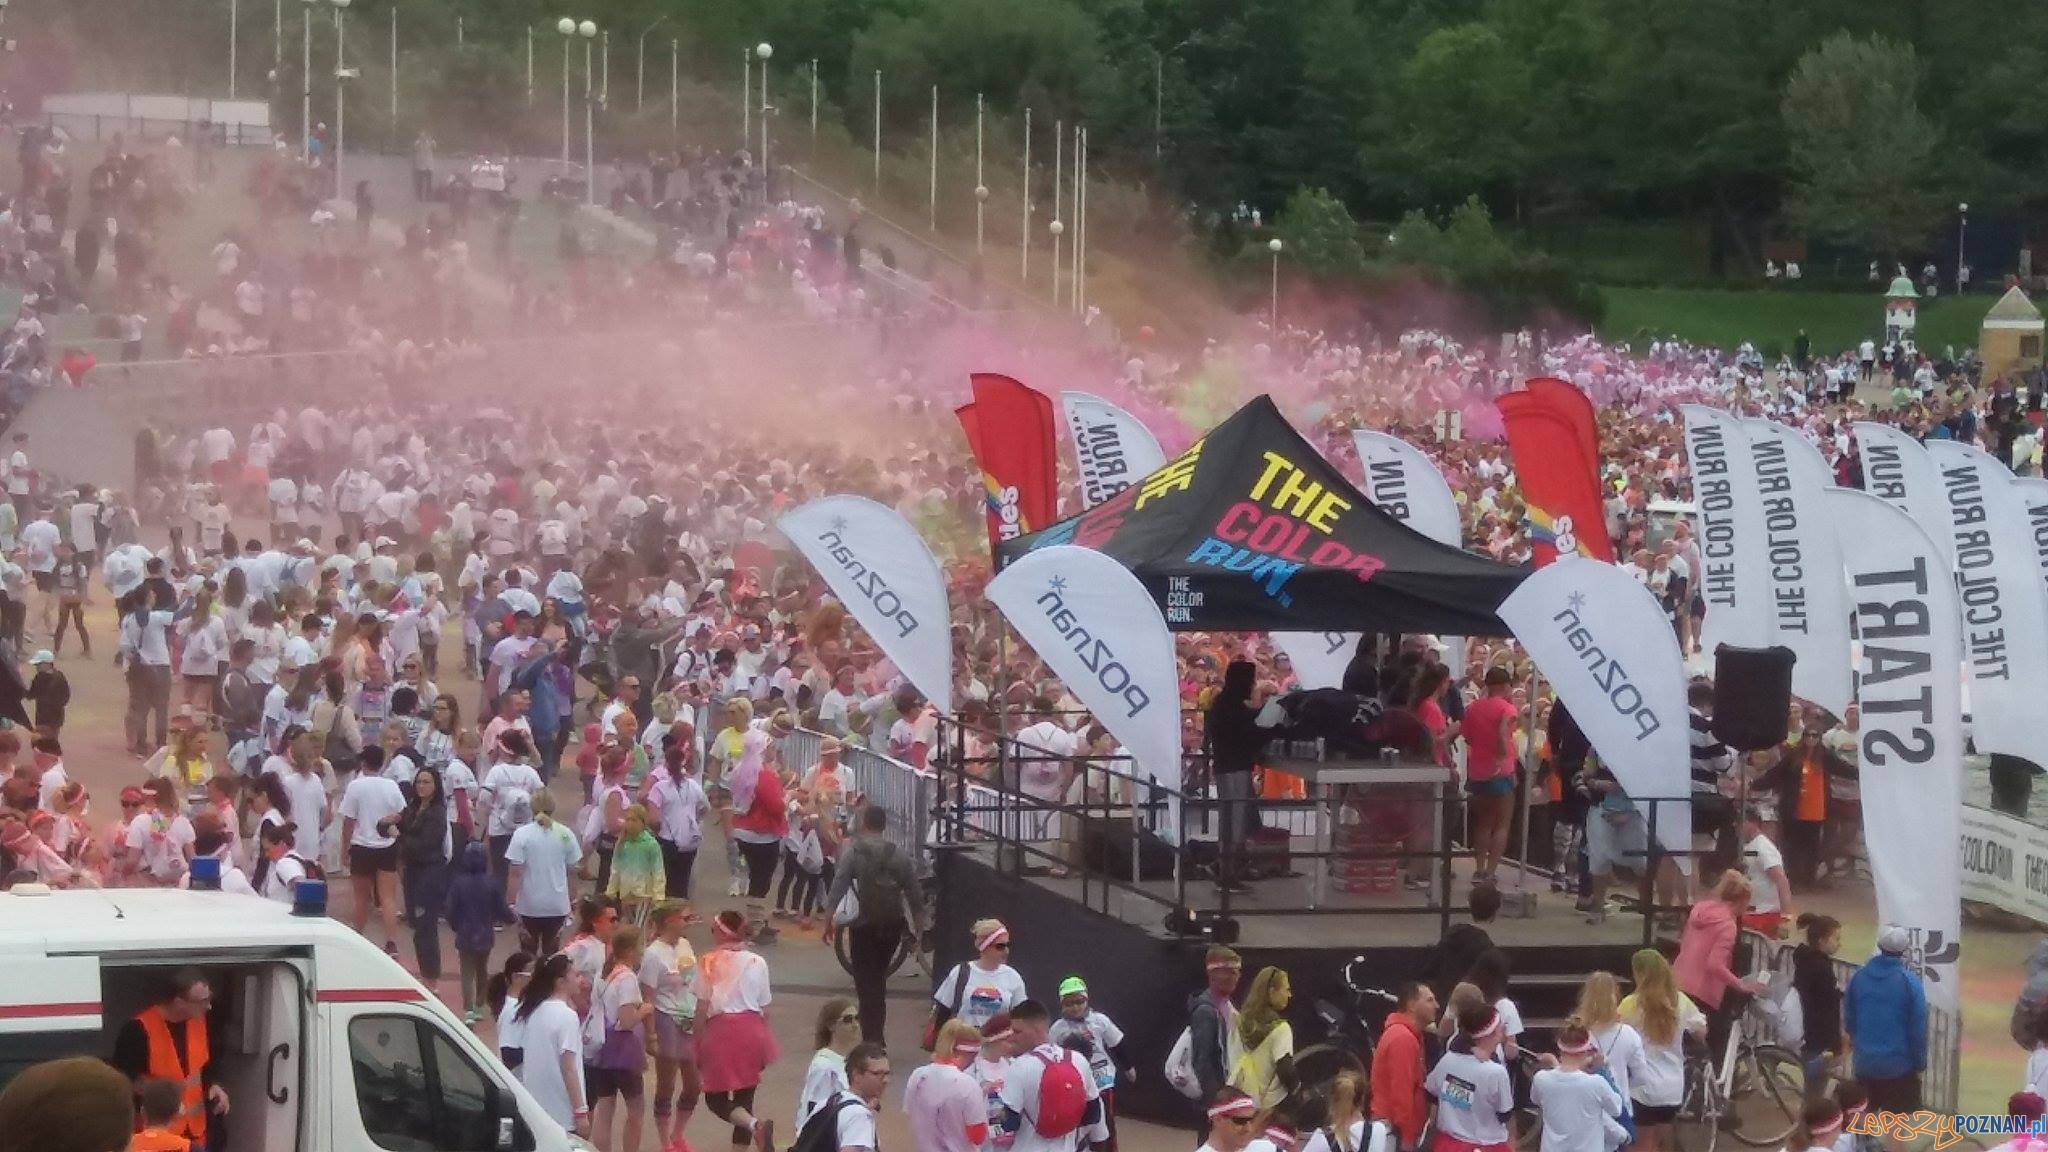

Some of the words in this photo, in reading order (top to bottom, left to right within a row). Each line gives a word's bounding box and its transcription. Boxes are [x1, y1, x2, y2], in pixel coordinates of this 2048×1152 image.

[1249, 451, 1352, 535] THE
[1215, 502, 1387, 583] COLOR
[1168, 576, 1190, 591] THE
[1168, 592, 1204, 606] COLOR
